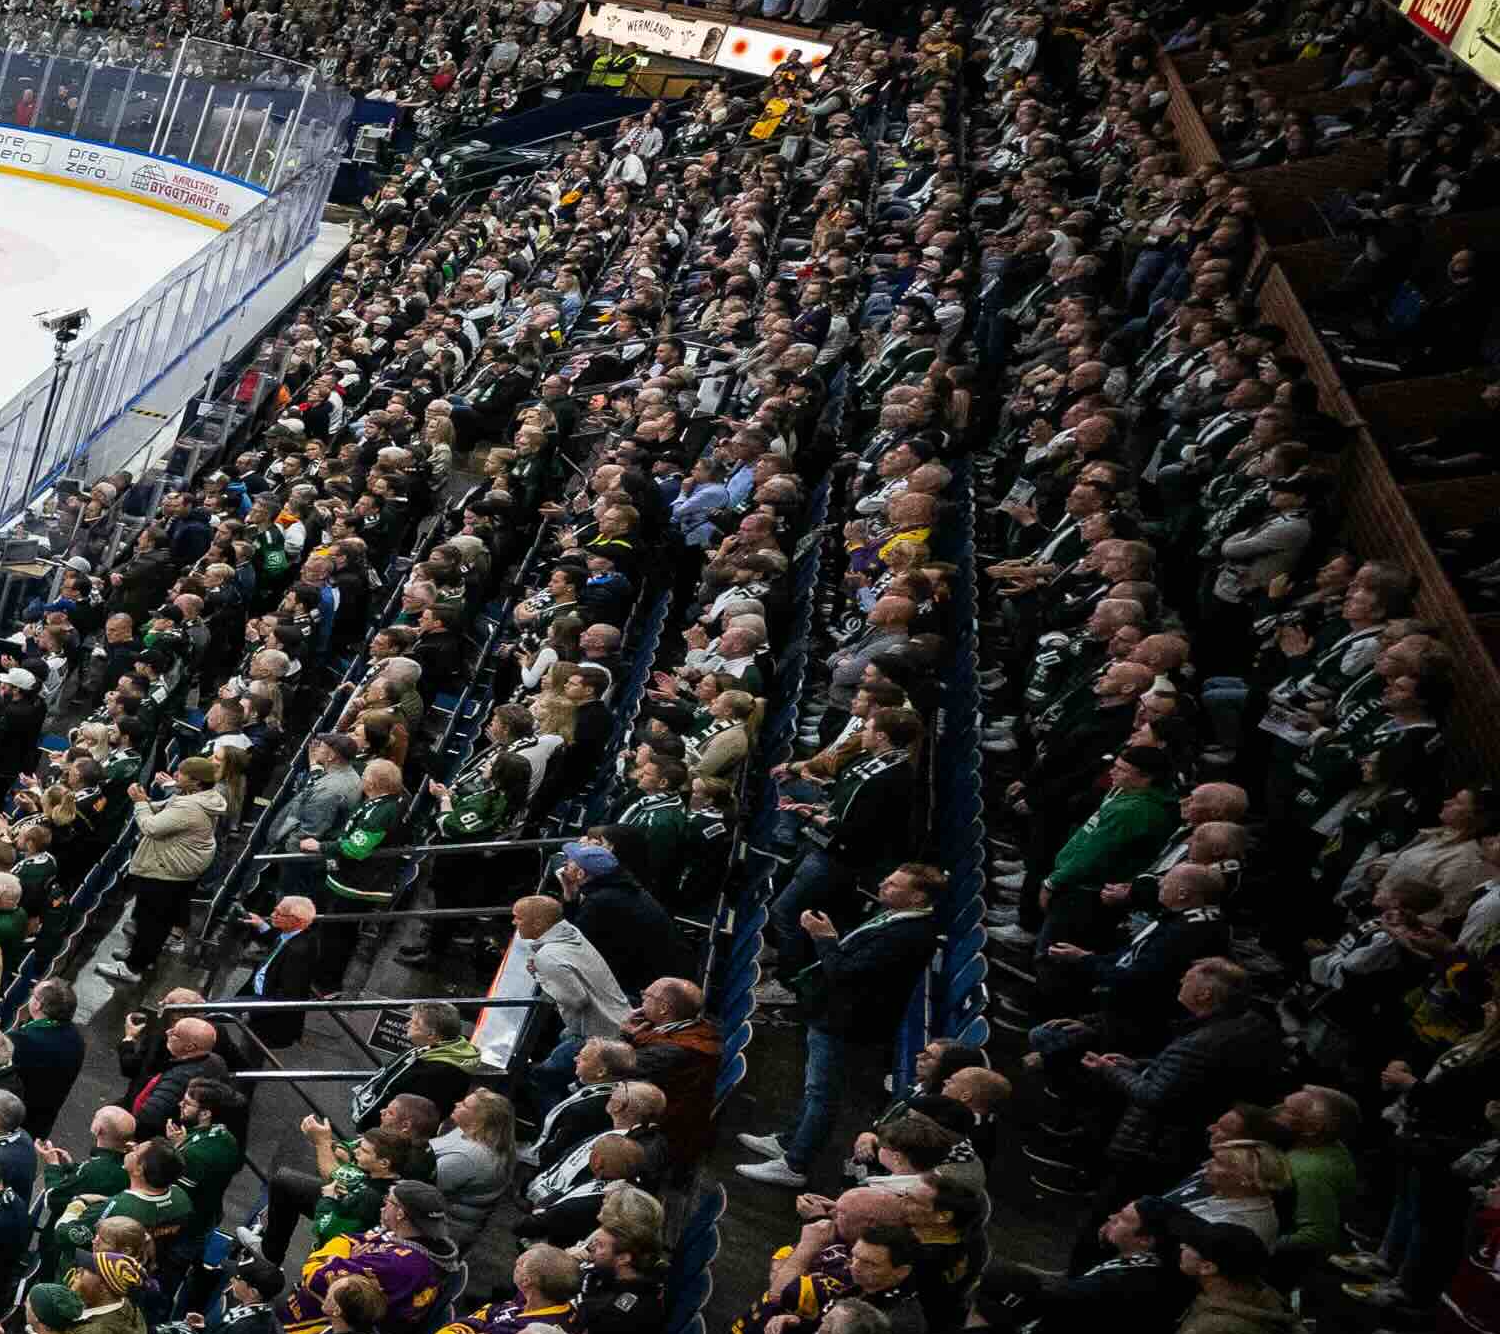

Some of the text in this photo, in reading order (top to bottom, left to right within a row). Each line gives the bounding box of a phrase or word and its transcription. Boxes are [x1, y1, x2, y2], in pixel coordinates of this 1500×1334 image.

[626, 19, 674, 42] WERMLANDS
[68, 146, 101, 166] pre
[65, 160, 107, 181] zero
